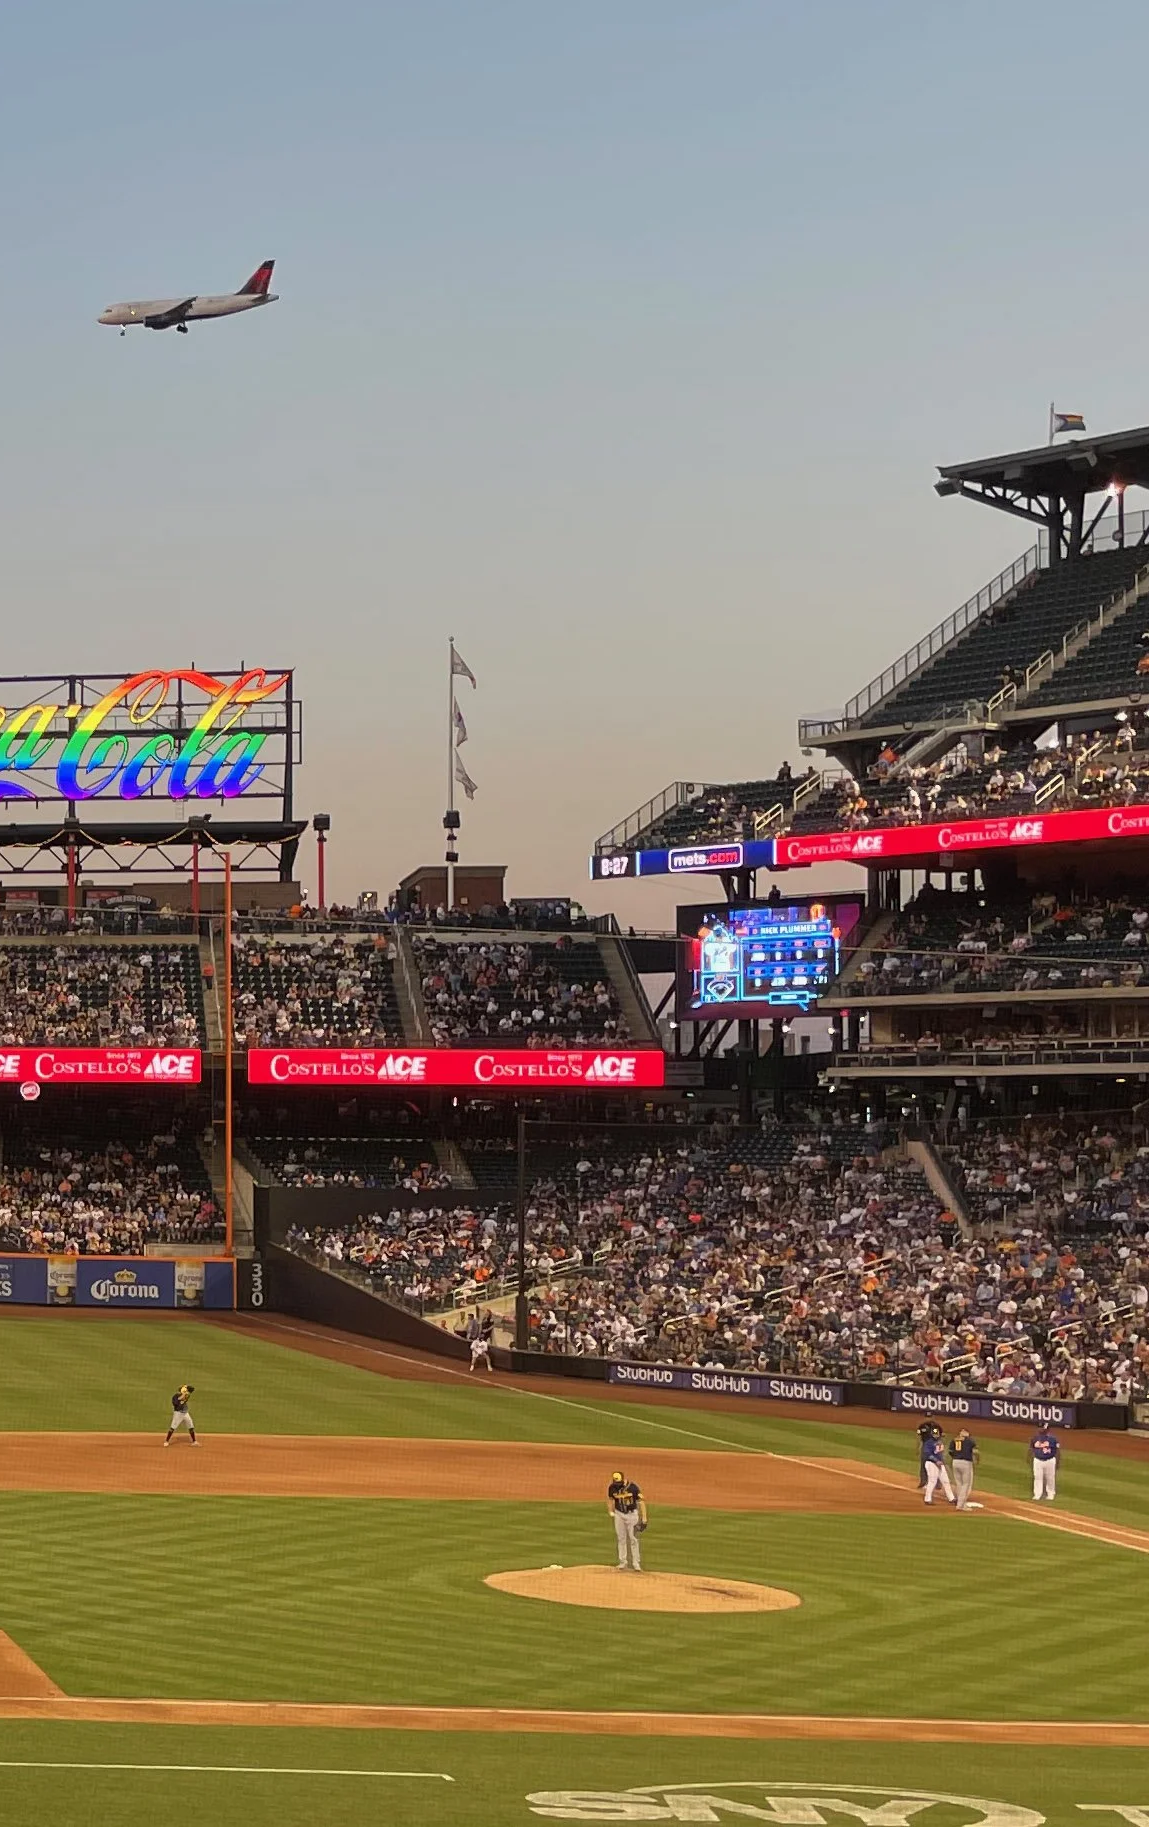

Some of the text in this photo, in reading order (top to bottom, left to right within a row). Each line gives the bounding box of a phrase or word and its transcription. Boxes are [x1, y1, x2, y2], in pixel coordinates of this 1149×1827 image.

[1010, 821, 1044, 840] ACE
[1108, 813, 1149, 833] COST
[853, 836, 883, 851] ACE
[673, 851, 738, 866] mets.com
[780, 925, 816, 934] PLUMMER
[143, 1051, 195, 1074] ACE
[377, 1053, 427, 1076] ACE
[585, 1054, 635, 1078] ACE
[91, 1279, 159, 1302] Corona
[252, 1263, 263, 1306] 330
[617, 1366, 673, 1383] StubHub
[691, 1373, 750, 1393] StubHub
[770, 1380, 832, 1401] StubHub
[902, 1391, 969, 1413] StubHub
[991, 1400, 1063, 1422] StubHub
[525, 1790, 939, 1826] SNY
